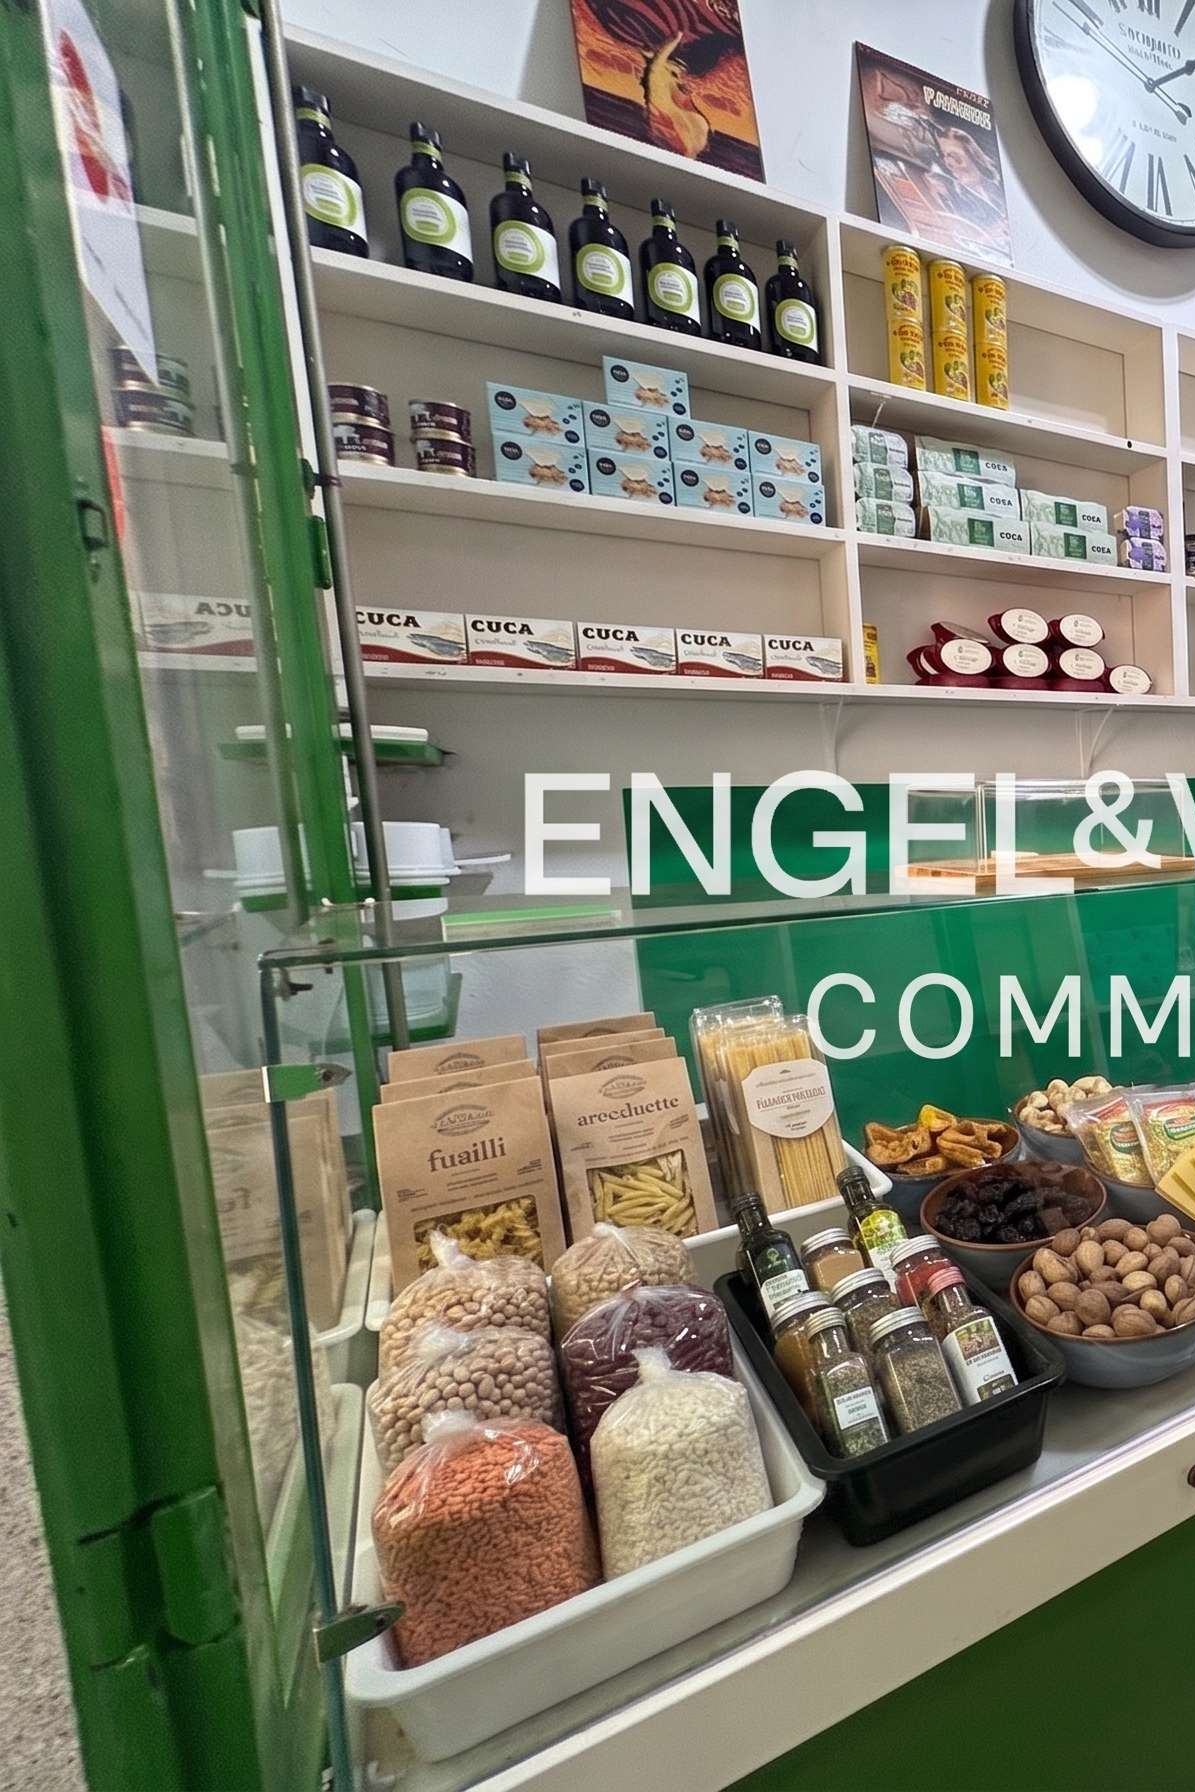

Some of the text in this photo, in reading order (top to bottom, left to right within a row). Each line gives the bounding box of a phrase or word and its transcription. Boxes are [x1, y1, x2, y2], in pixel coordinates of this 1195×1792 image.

[471, 619, 535, 636] CUCA
[582, 627, 640, 642] CUCA
[680, 633, 732, 647] CUCA
[768, 639, 815, 652] CUCA
